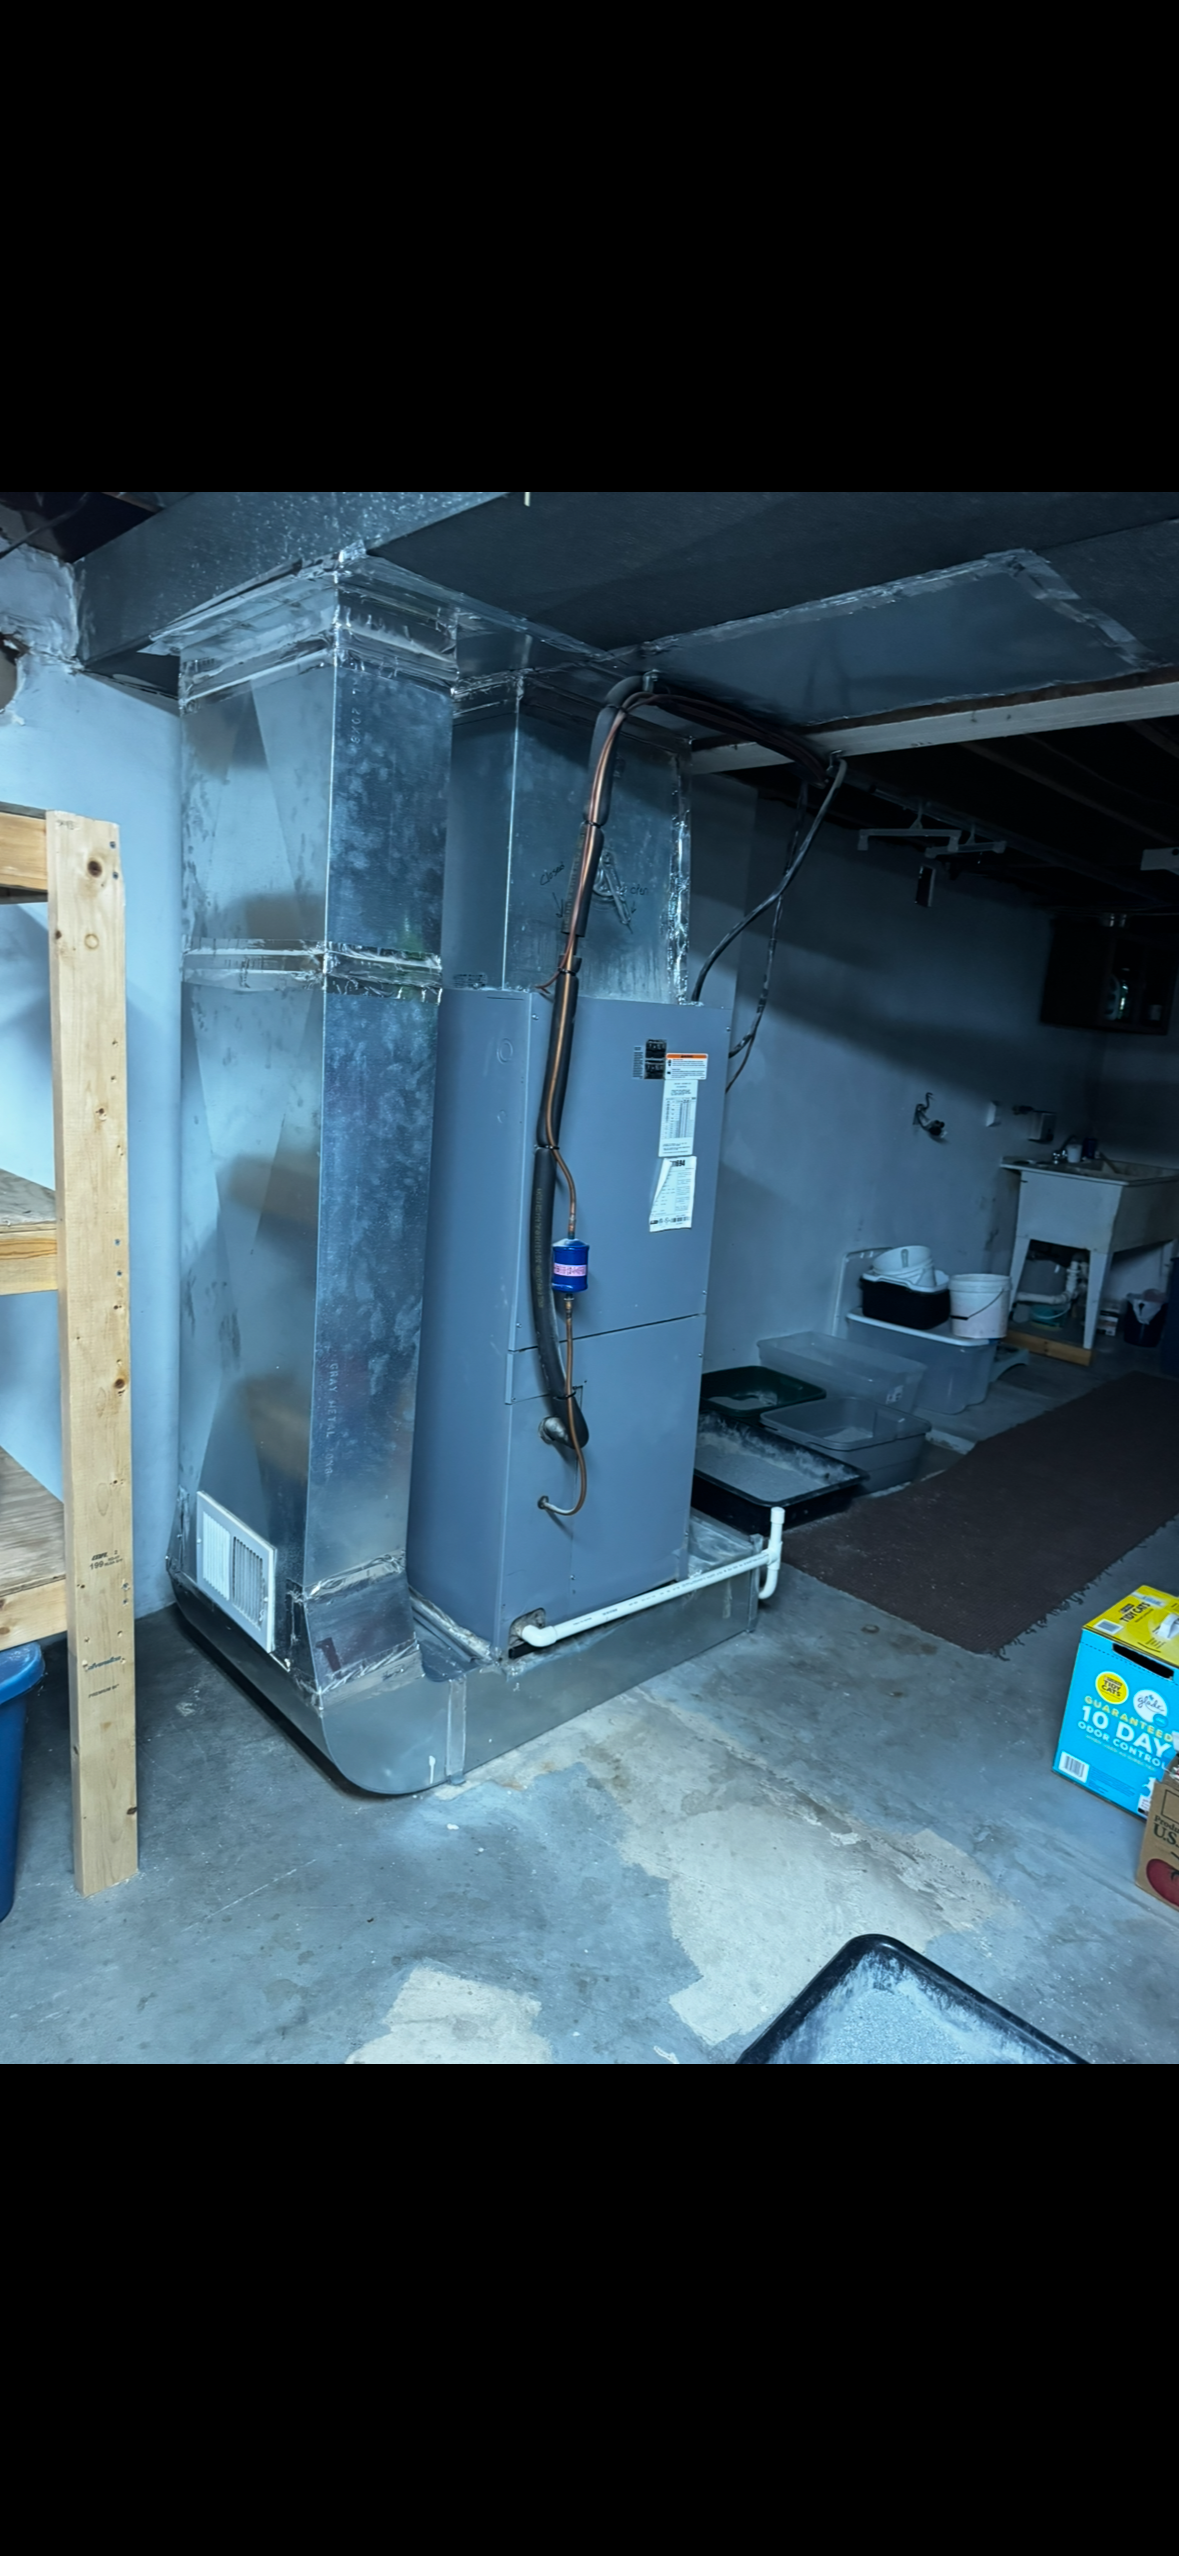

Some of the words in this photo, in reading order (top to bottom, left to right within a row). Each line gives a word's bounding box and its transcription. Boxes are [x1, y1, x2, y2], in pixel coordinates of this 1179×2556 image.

[328, 1362, 339, 1393] GRAY
[89, 1560, 104, 1570] 199
[1101, 1684, 1122, 1697] CATS
[1103, 1679, 1121, 1691] TIDY
[1082, 1705, 1109, 1730] 10
[1115, 1721, 1172, 1758] DAY
[1084, 1695, 1173, 1742] GUARANTEED
[1077, 1721, 1110, 1742] ODOR
[1112, 1738, 1167, 1770] CONTROL
